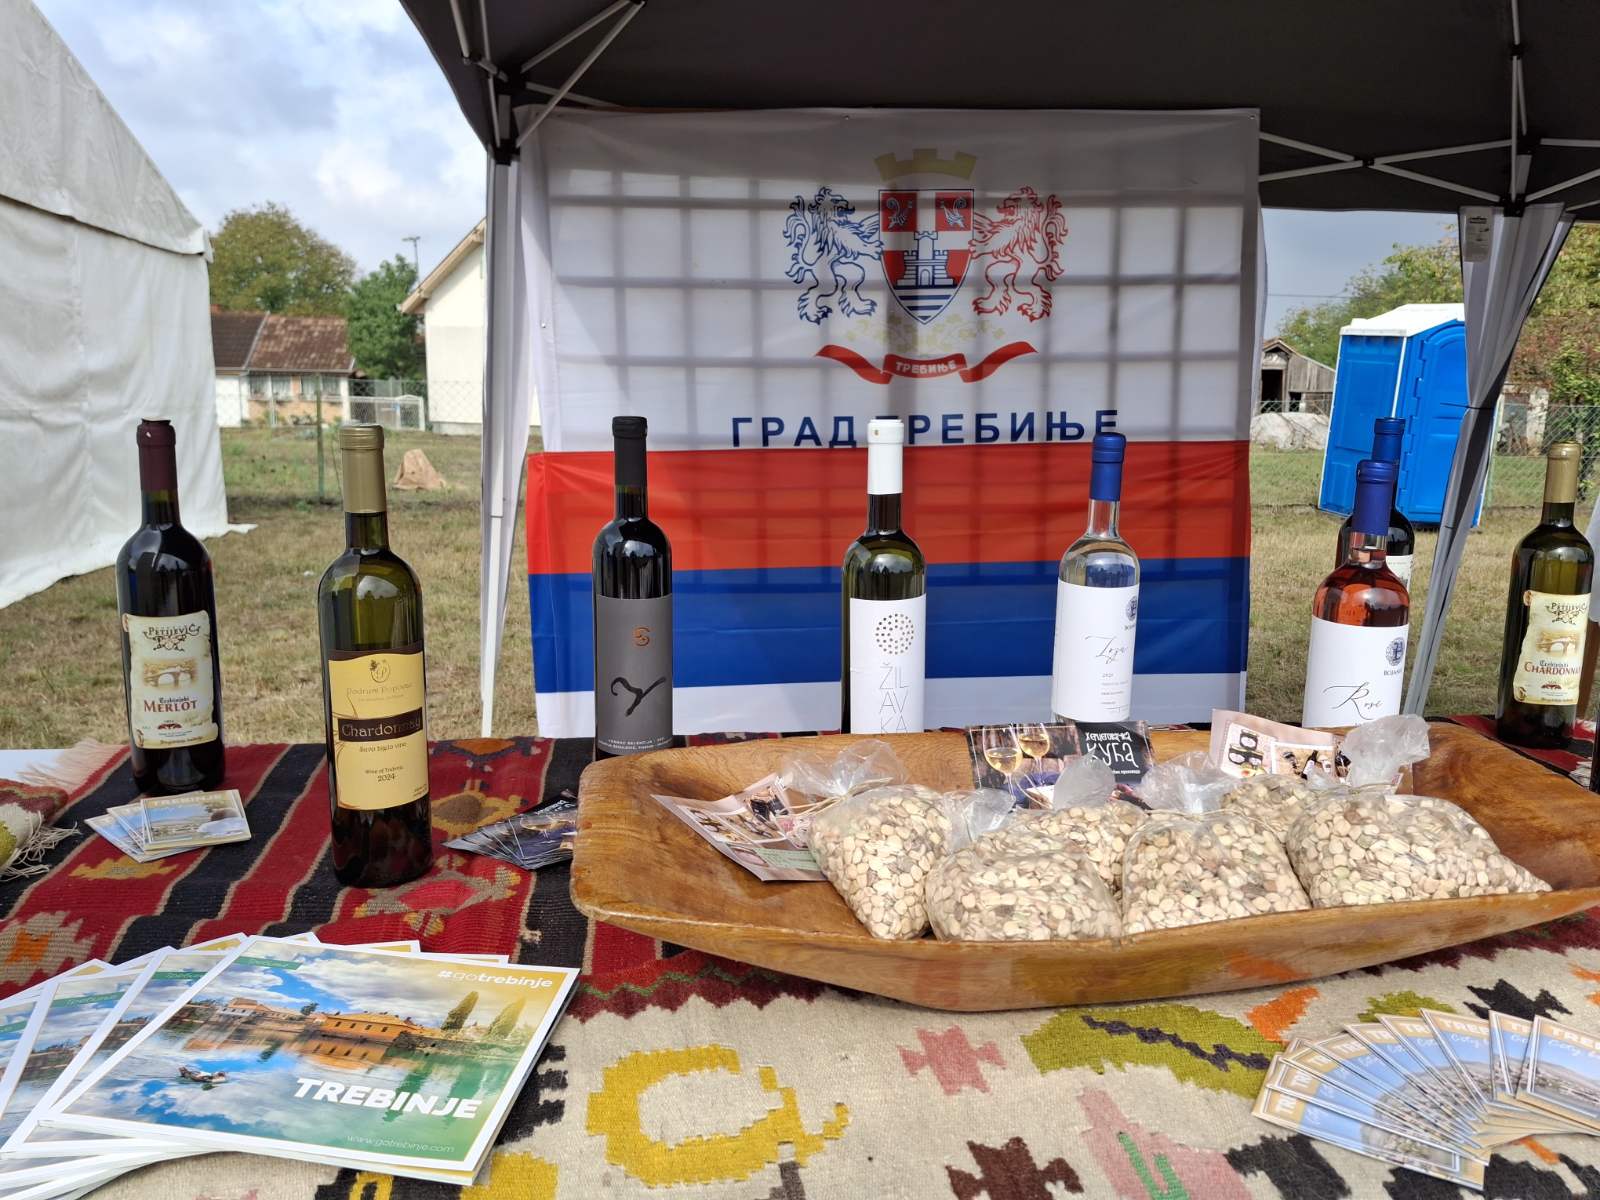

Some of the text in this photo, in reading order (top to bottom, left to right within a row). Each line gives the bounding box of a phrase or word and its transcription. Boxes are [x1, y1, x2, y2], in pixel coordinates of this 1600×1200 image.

[895, 359, 957, 375] ТРЕБИЊЕ
[732, 410, 1119, 448] ГРАД РЕБИЊЕ
[143, 699, 198, 713] MERLOT
[438, 969, 553, 989] #gotrebinje
[295, 1078, 482, 1119] TREBINJE
